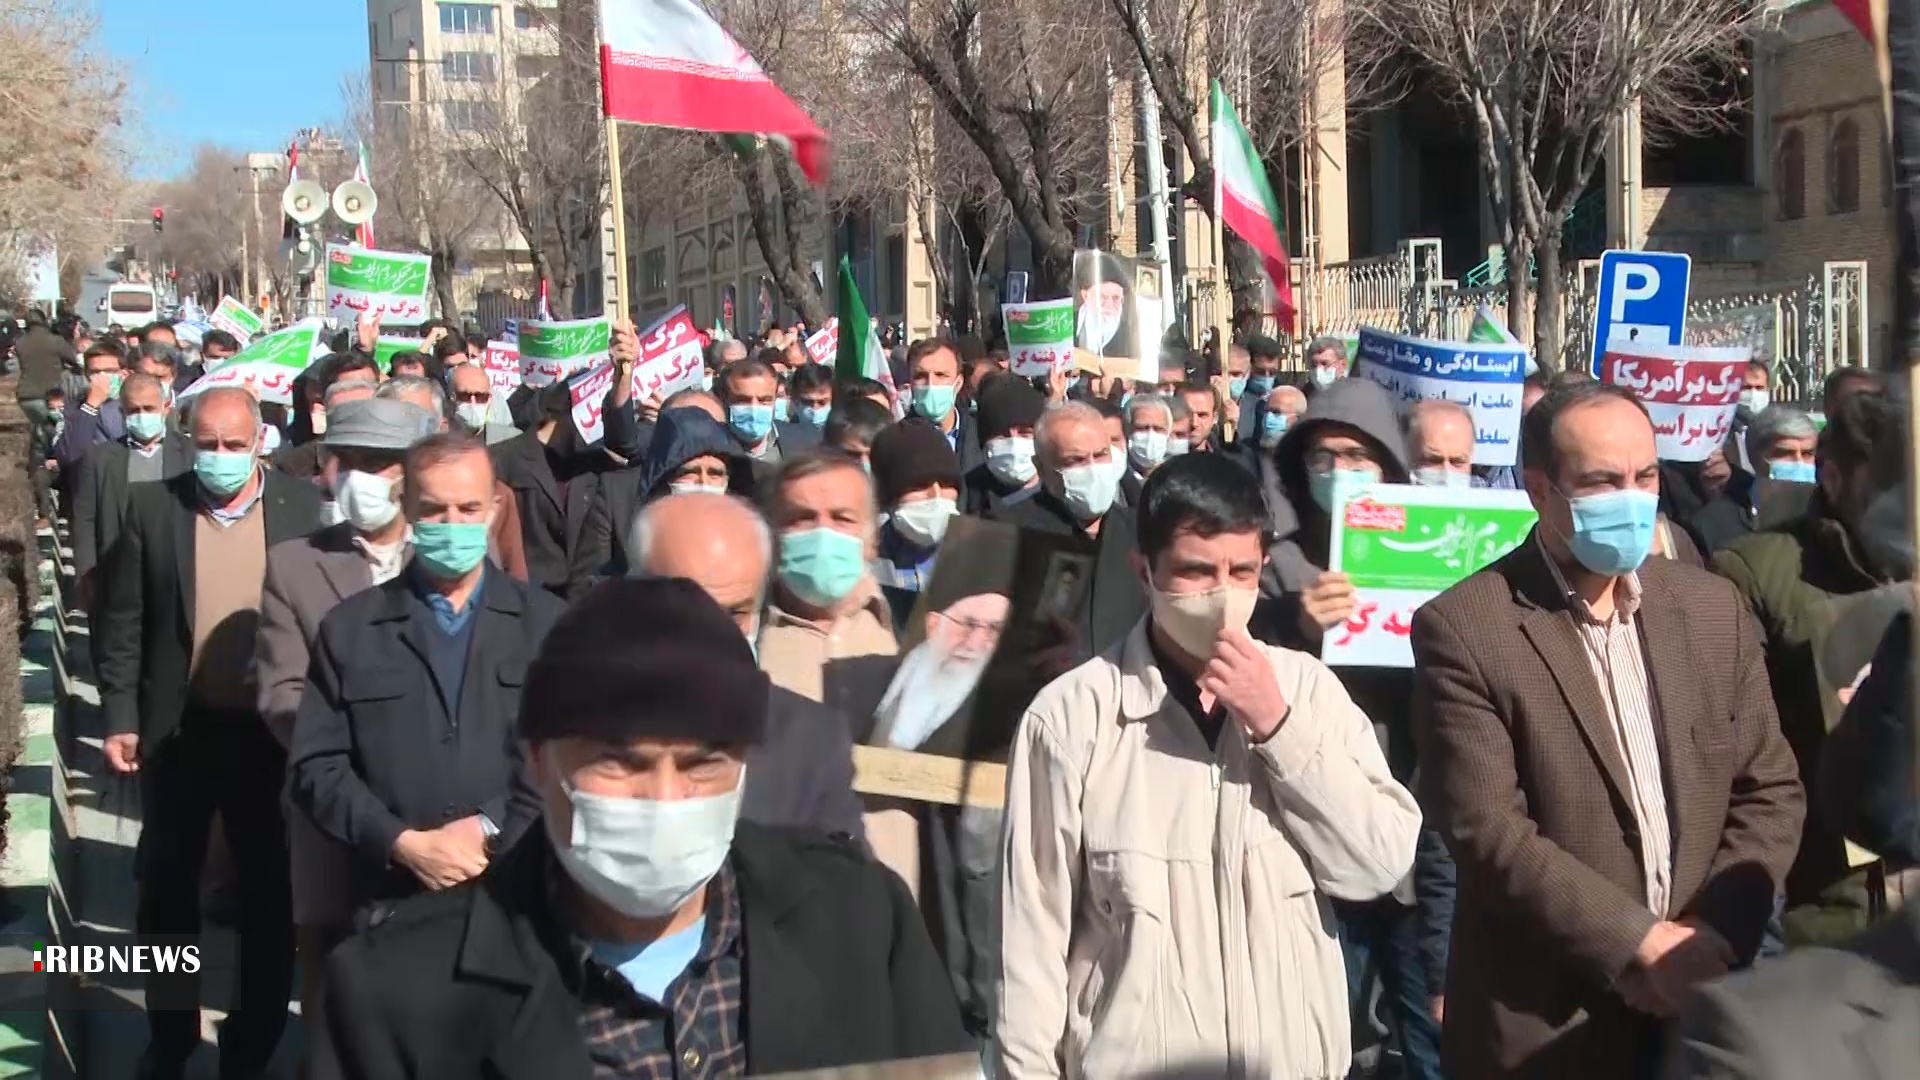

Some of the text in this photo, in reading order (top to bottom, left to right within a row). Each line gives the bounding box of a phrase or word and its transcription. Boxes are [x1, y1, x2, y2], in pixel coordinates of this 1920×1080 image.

[1610, 262, 1660, 322] P
[329, 293, 420, 318] مرگ بر فتنه گر
[645, 322, 687, 352] مرگ
[664, 353, 700, 381] مرگ
[1015, 349, 1028, 368] گر
[1031, 347, 1056, 364] فتنه
[1363, 337, 1519, 377] ایستادگی و مقاومت
[1613, 358, 1688, 400] آمریکا
[1678, 374, 1705, 402] بر
[1481, 393, 1514, 409] ملت
[1475, 428, 1511, 445] سلط
[1681, 421, 1704, 446] بر
